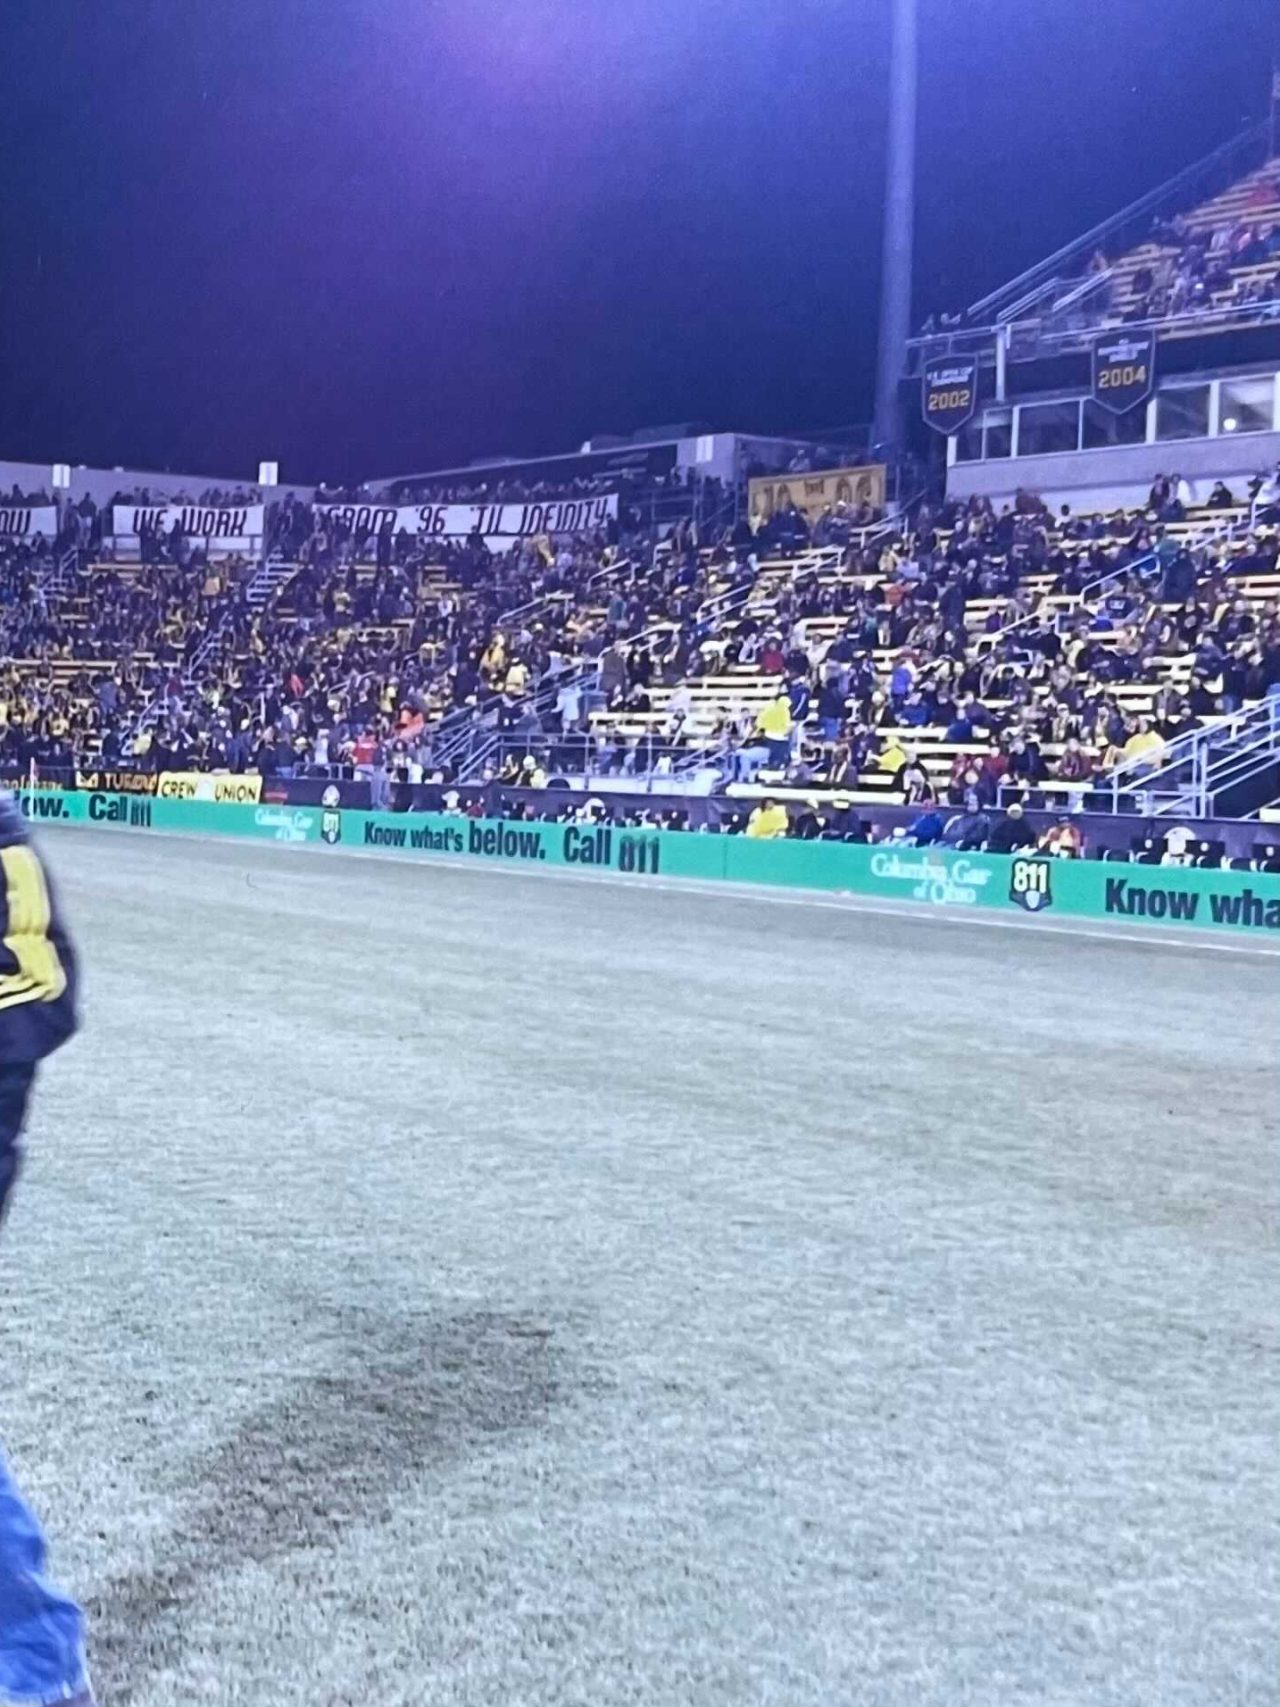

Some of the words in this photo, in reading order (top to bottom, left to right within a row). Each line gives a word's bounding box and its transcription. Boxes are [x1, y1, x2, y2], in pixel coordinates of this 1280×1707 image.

[1098, 365, 1146, 388] 2004
[928, 390, 970, 411] 2002
[181, 507, 247, 537] WORK
[161, 780, 197, 800] CREW
[215, 785, 257, 802] UNION
[88, 794, 128, 821] Call
[364, 820, 407, 847] Know
[410, 825, 463, 852] what's
[468, 820, 546, 860] below.
[563, 825, 613, 866] Call
[1013, 860, 1048, 894] 811
[1105, 877, 1200, 921] Know
